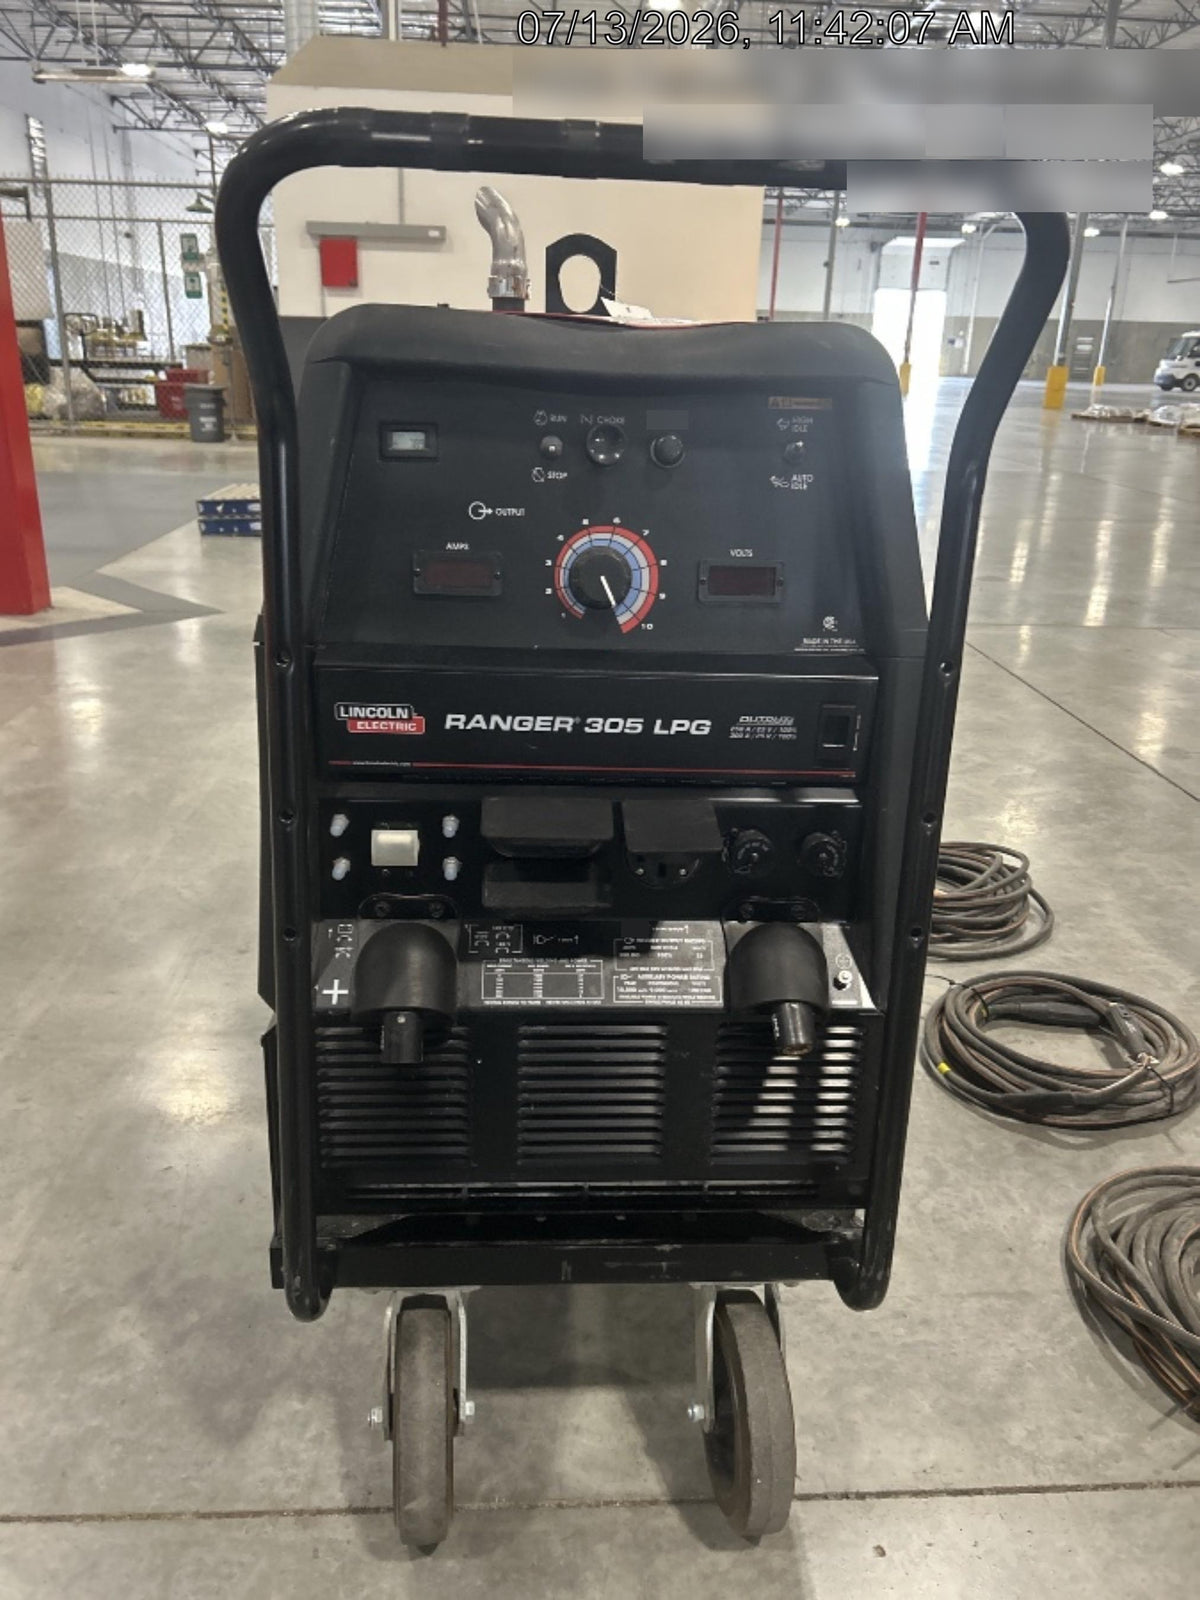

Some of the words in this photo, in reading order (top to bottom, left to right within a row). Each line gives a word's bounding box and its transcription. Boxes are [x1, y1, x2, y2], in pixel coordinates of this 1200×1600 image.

[547, 470, 568, 480] STOP
[791, 473, 814, 482] AUTO
[495, 507, 526, 517] OUTPUT
[445, 541, 470, 551] AMPS
[729, 548, 754, 558] VOLTS
[339, 705, 409, 719] LINCOLN
[356, 720, 417, 731] ELECTRIC
[584, 717, 645, 734] 305
[653, 718, 712, 735] LPG
